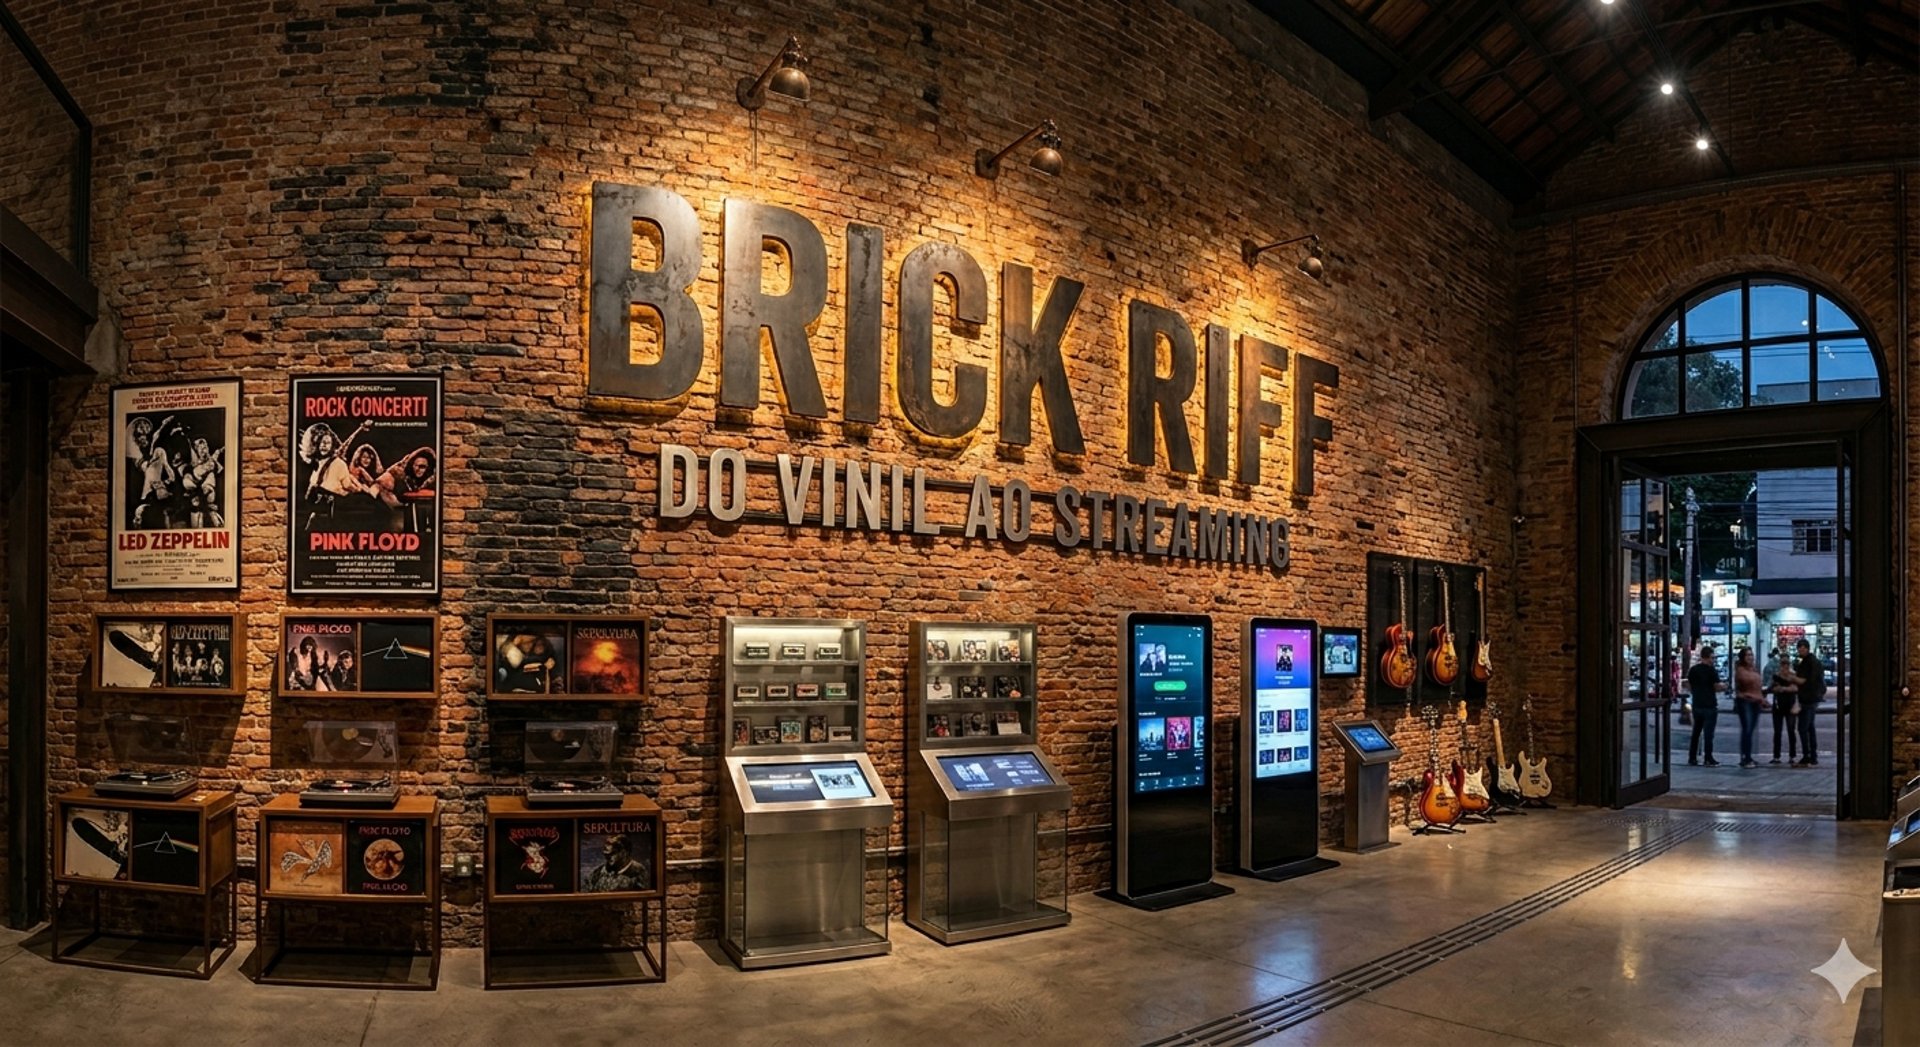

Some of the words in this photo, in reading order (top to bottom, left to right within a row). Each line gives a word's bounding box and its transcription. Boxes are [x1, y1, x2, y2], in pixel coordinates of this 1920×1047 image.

[588, 180, 1085, 454] BRICK
[1128, 298, 1340, 496] RIFF
[305, 396, 348, 417] ROCK
[660, 443, 746, 522] DO
[777, 453, 940, 535] VINIL
[965, 474, 1032, 543] AO
[1055, 485, 1290, 568] STREAMING
[118, 533, 148, 551] LED
[150, 531, 230, 550] ZEPPELIN
[310, 532, 354, 551] PINK
[358, 532, 420, 551] FLOYD
[582, 822, 652, 834] SEPULTURA
